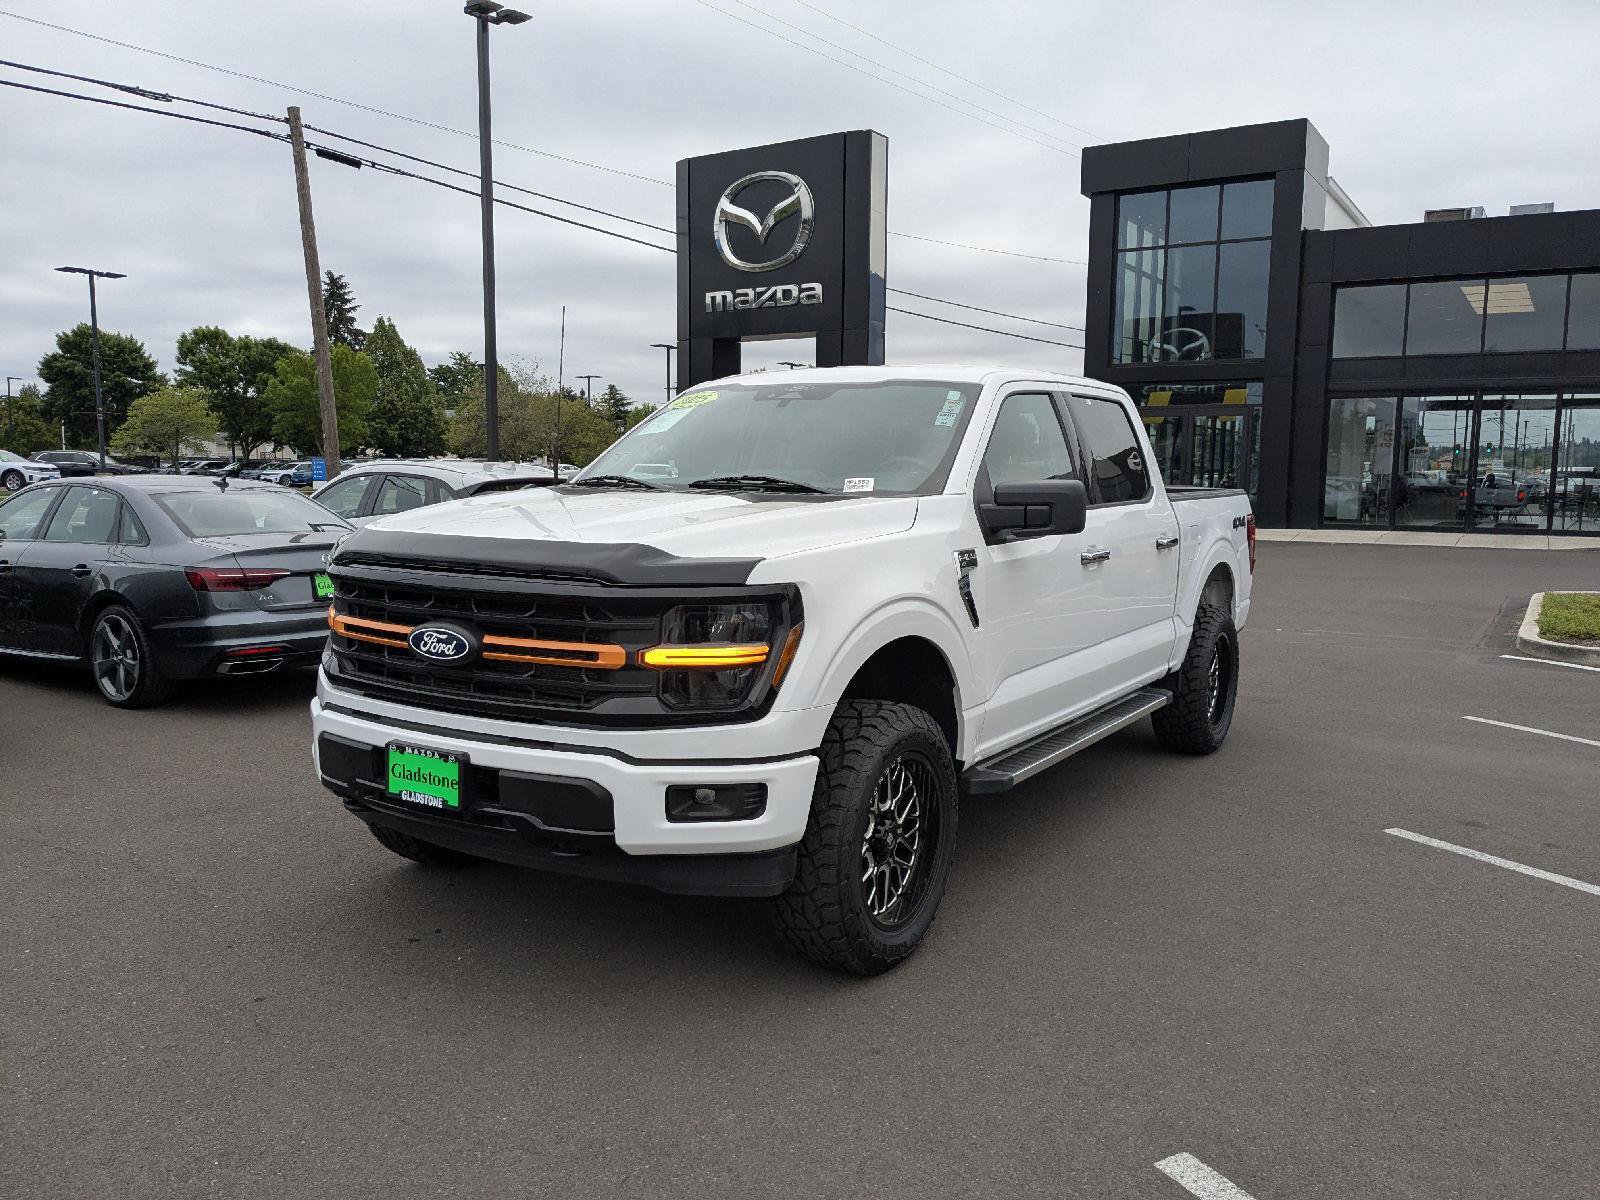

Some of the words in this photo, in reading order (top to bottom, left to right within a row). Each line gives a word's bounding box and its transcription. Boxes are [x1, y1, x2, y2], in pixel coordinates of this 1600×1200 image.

[705, 282, 823, 313] mazda
[420, 631, 457, 655] Ford
[404, 746, 440, 759] MAZDA
[391, 763, 459, 790] Gladstone
[401, 790, 443, 809] GLADSTONE
